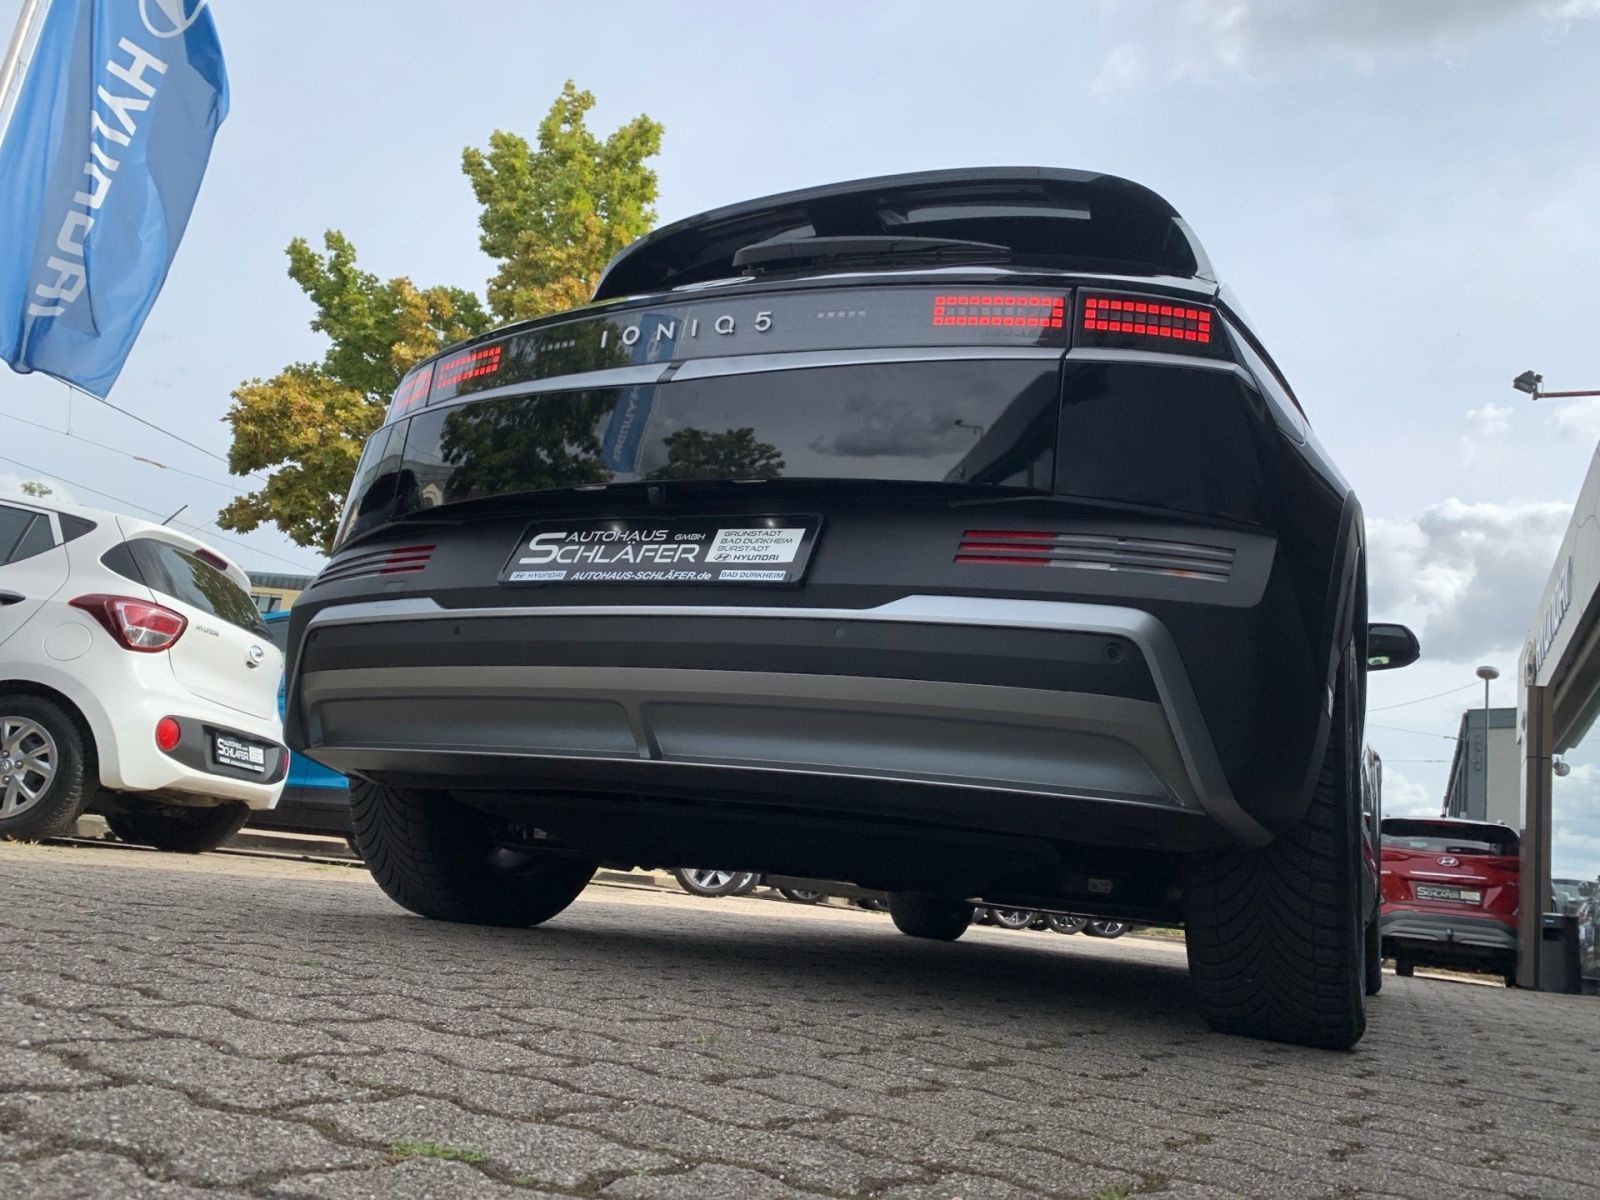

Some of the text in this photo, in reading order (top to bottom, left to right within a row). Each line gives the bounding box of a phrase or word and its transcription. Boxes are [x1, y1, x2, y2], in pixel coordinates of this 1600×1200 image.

[27, 36, 169, 318] HYUNDAI
[600, 310, 773, 349] IONIQ 5
[518, 532, 701, 564] SCHLÄFER
[565, 530, 669, 542] AUTOHAUS
